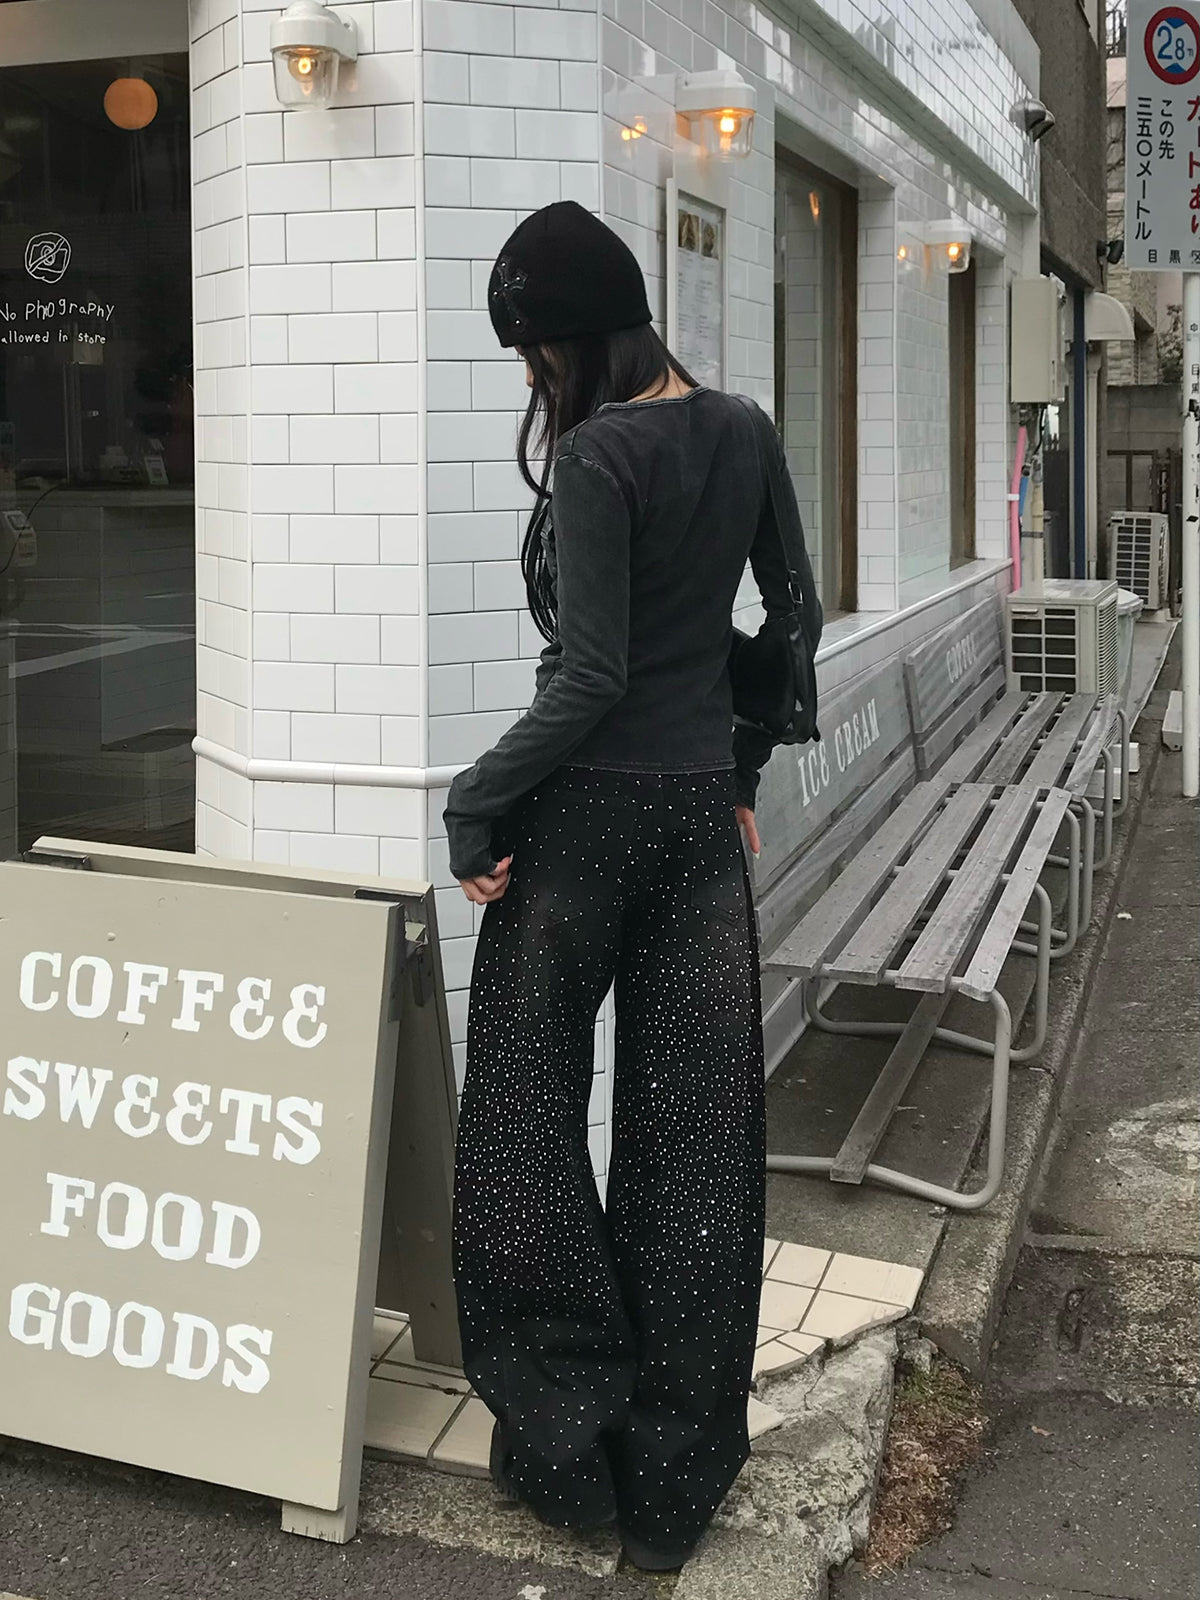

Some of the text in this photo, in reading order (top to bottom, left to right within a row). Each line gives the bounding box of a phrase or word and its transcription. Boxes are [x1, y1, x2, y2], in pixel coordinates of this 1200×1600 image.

[1159, 99, 1175, 160] この先
[0, 303, 17, 321] No
[1, 329, 107, 344] allowed in store
[798, 698, 881, 807] ICE CREAM
[19, 951, 328, 1048] COFFEE
[3, 1056, 324, 1165] SWEETS
[40, 1172, 261, 1269] FOOD
[8, 1282, 273, 1393] GOODS
